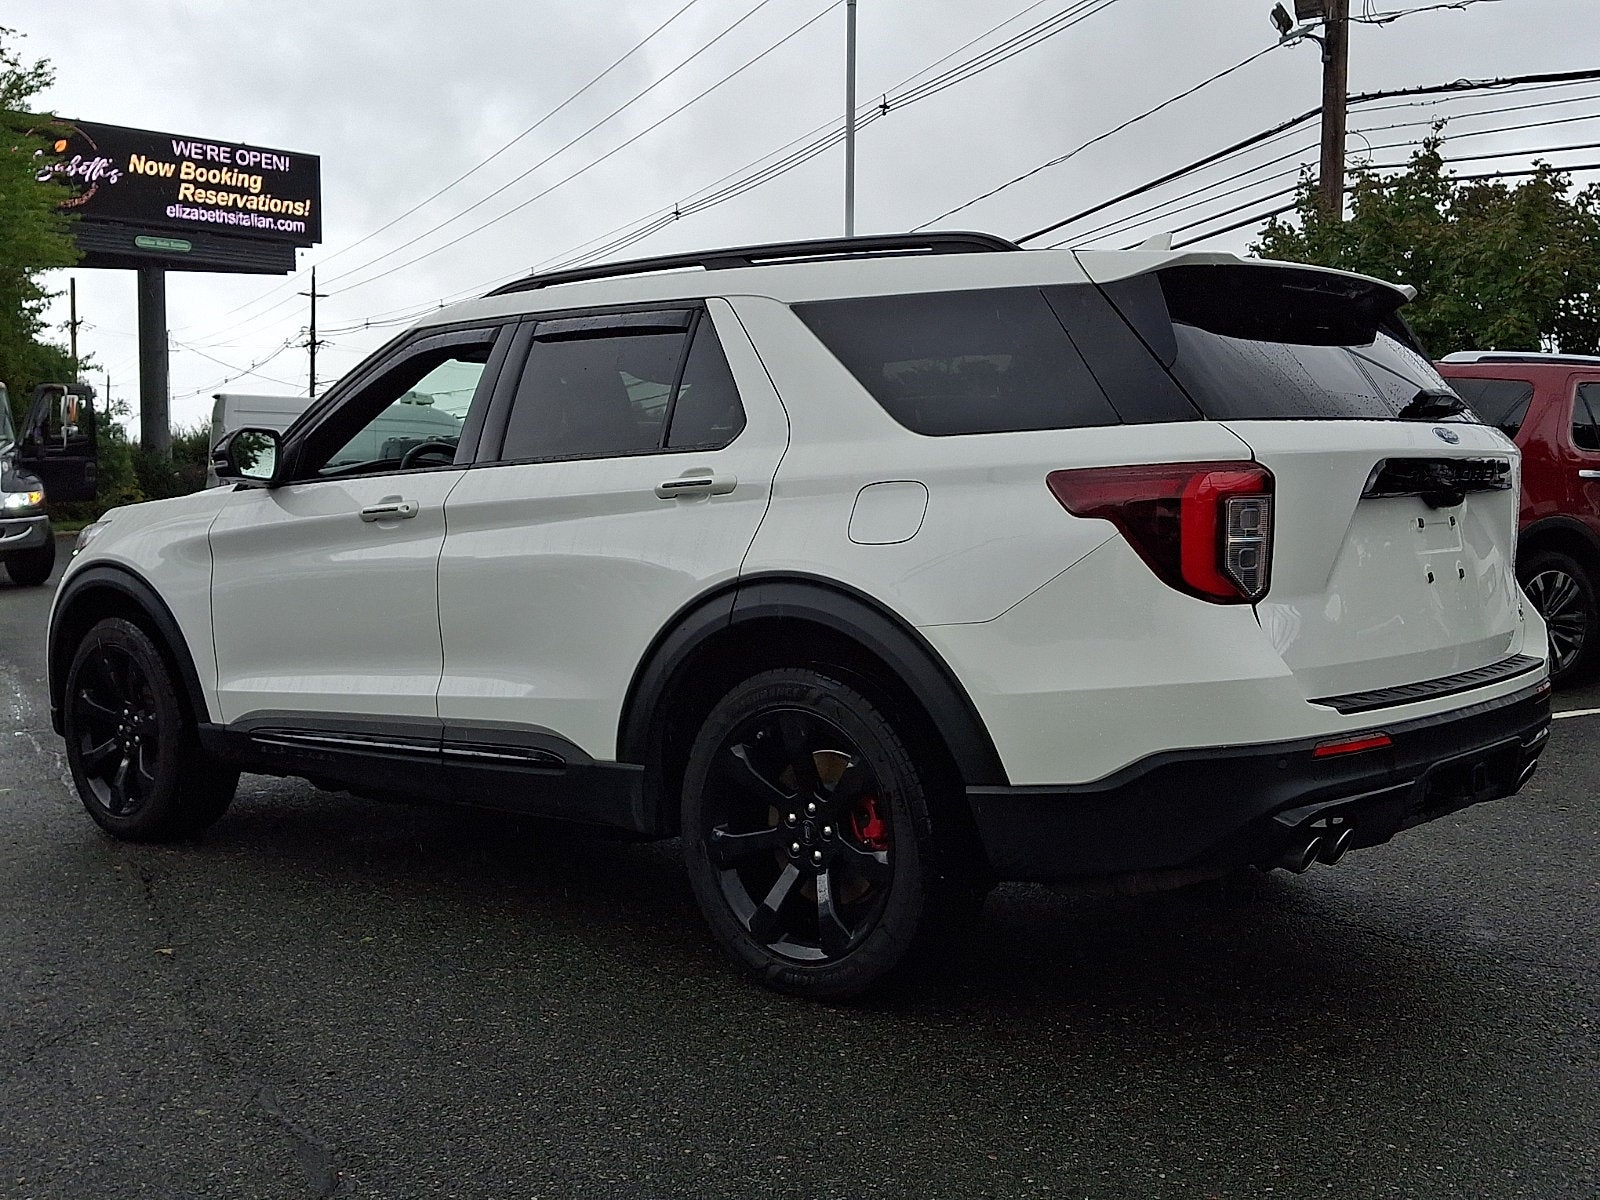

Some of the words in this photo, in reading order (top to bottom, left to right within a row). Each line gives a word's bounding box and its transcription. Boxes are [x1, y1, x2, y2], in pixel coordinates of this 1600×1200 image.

[172, 139, 232, 164] WE'RE
[235, 149, 290, 172] OPEN!
[128, 153, 176, 178] Now
[179, 160, 263, 194] Booking
[178, 182, 311, 217] Reservations!
[166, 203, 306, 233] elizabethsitalian.com
